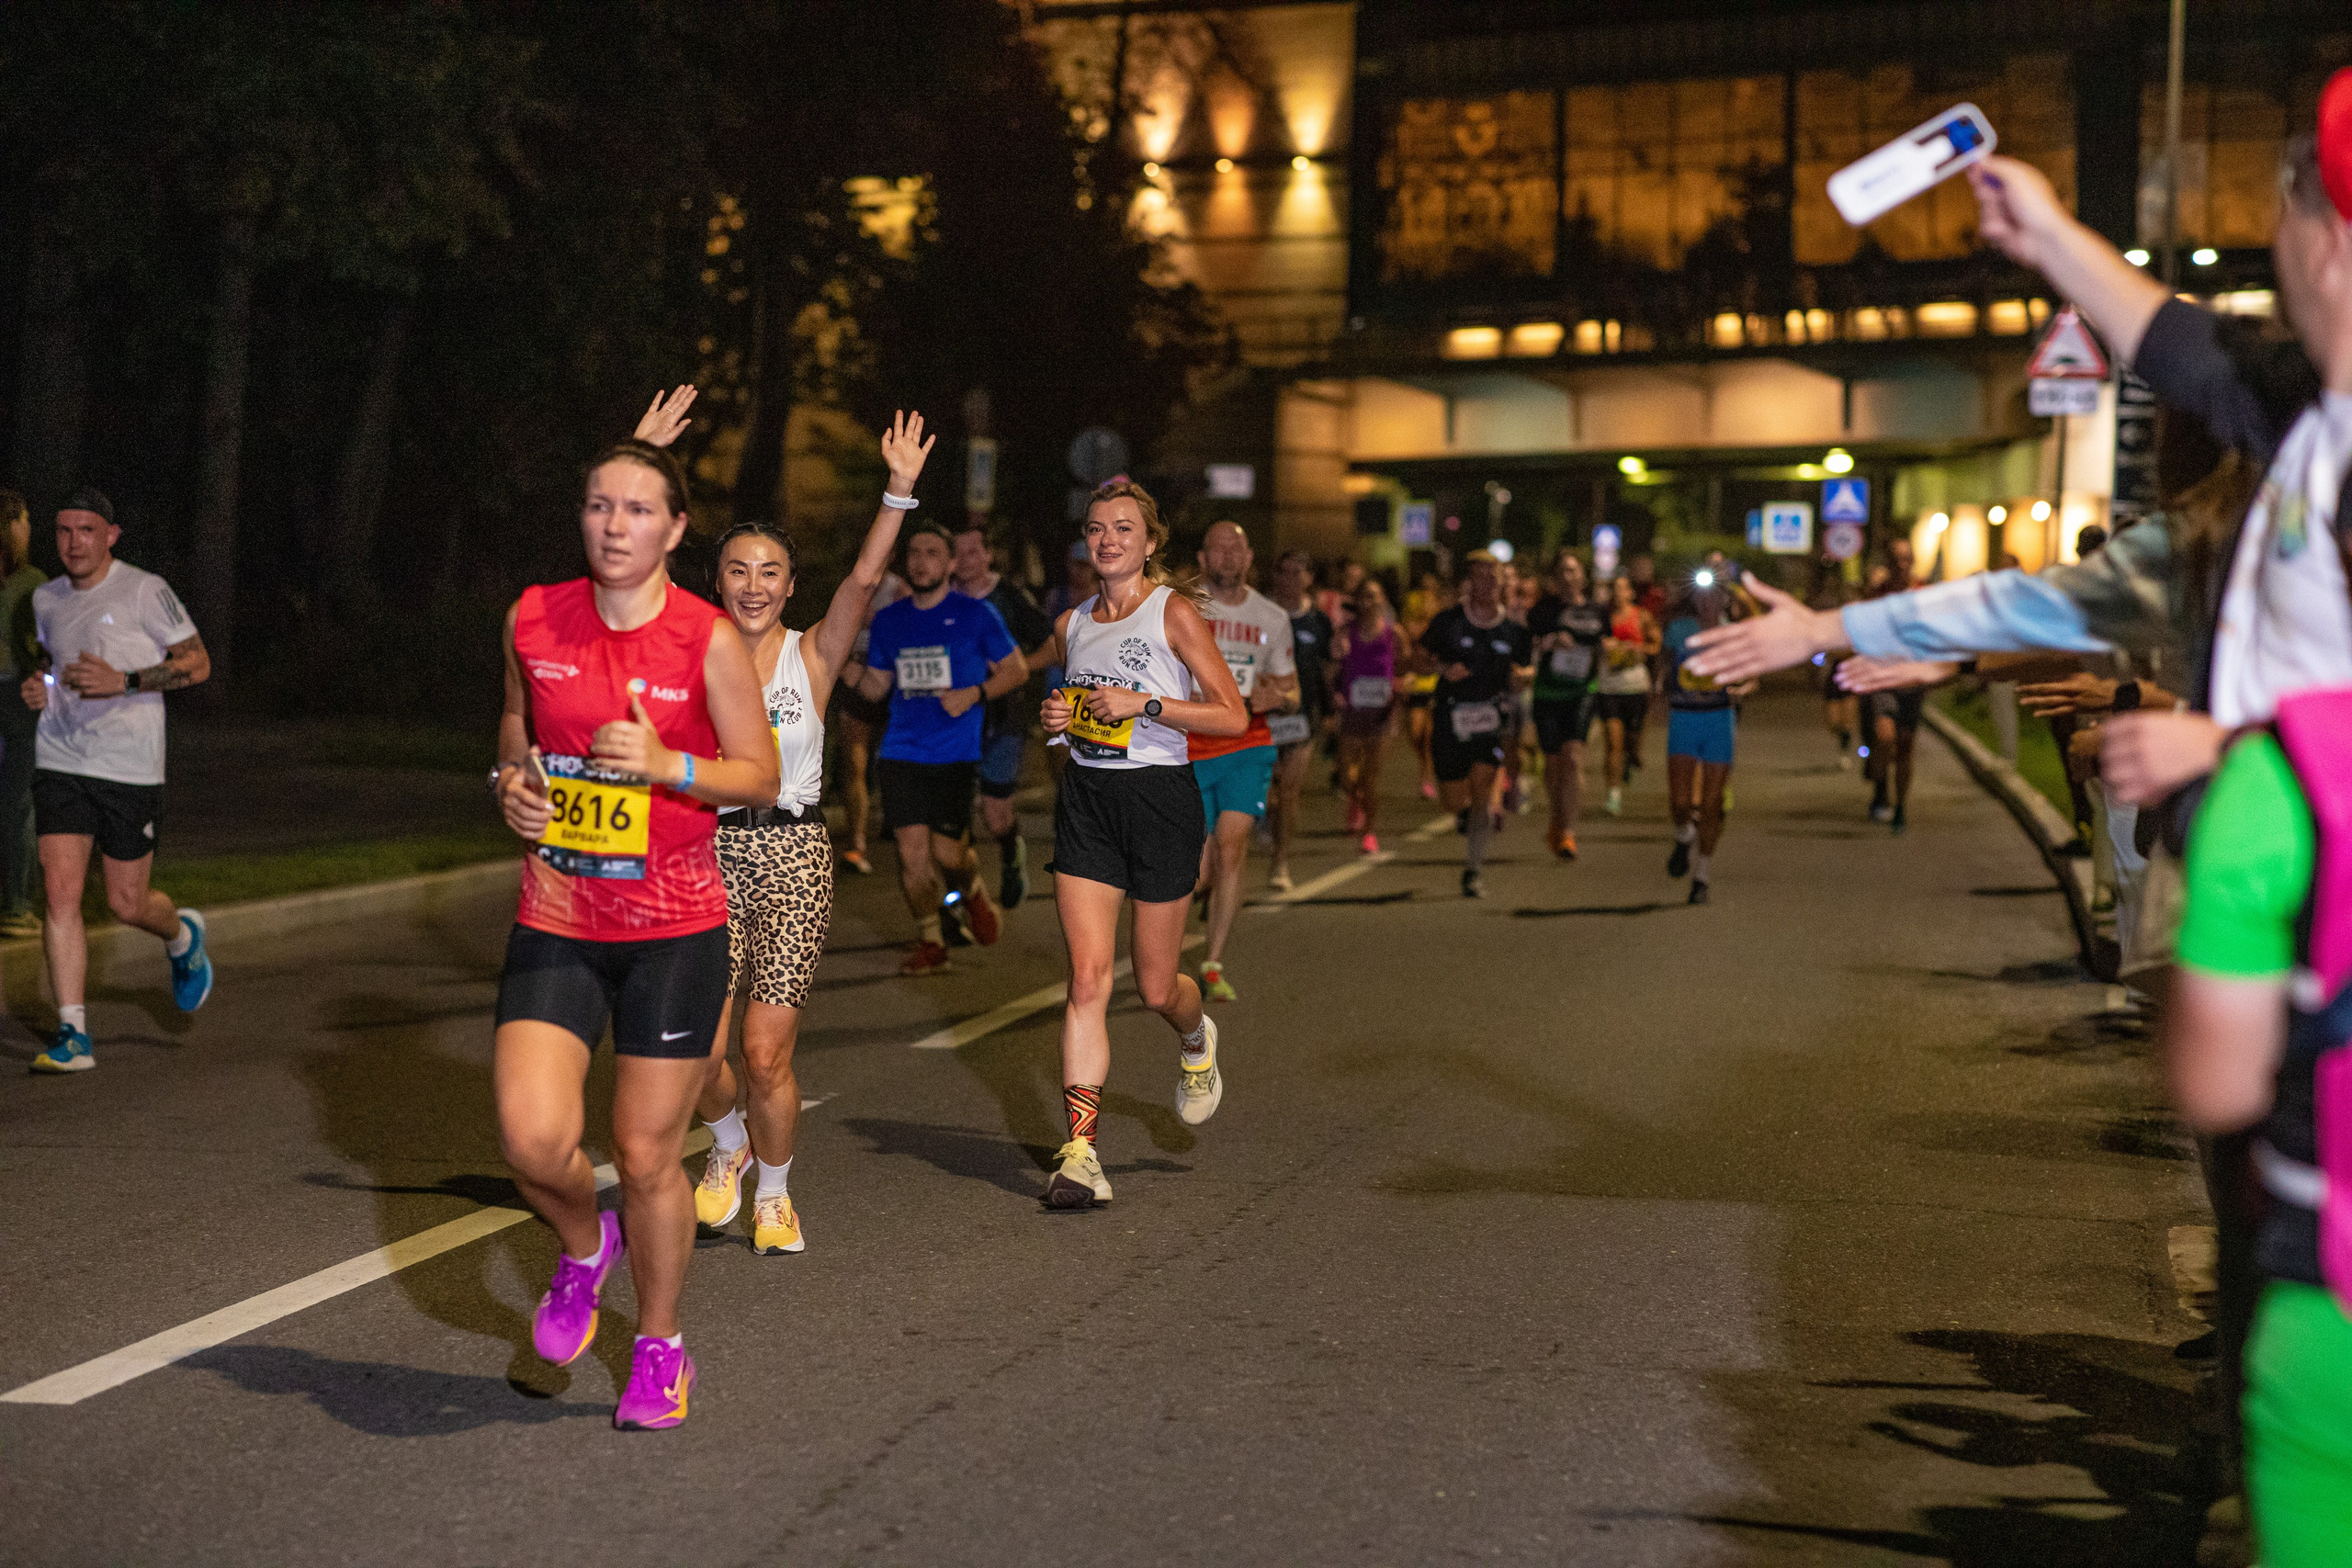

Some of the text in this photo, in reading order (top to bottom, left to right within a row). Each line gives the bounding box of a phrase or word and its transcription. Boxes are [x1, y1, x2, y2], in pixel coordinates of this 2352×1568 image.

[1120, 637, 1132, 649] CUP
[1141, 642, 1152, 657] RUN
[1118, 655, 1148, 671] RUN CLUB
[769, 686, 803, 704] CUP OF RUN
[786, 712, 802, 725] CLUB
[1072, 722, 1112, 739] АНАСТАСИЯ
[551, 787, 631, 831] 8616
